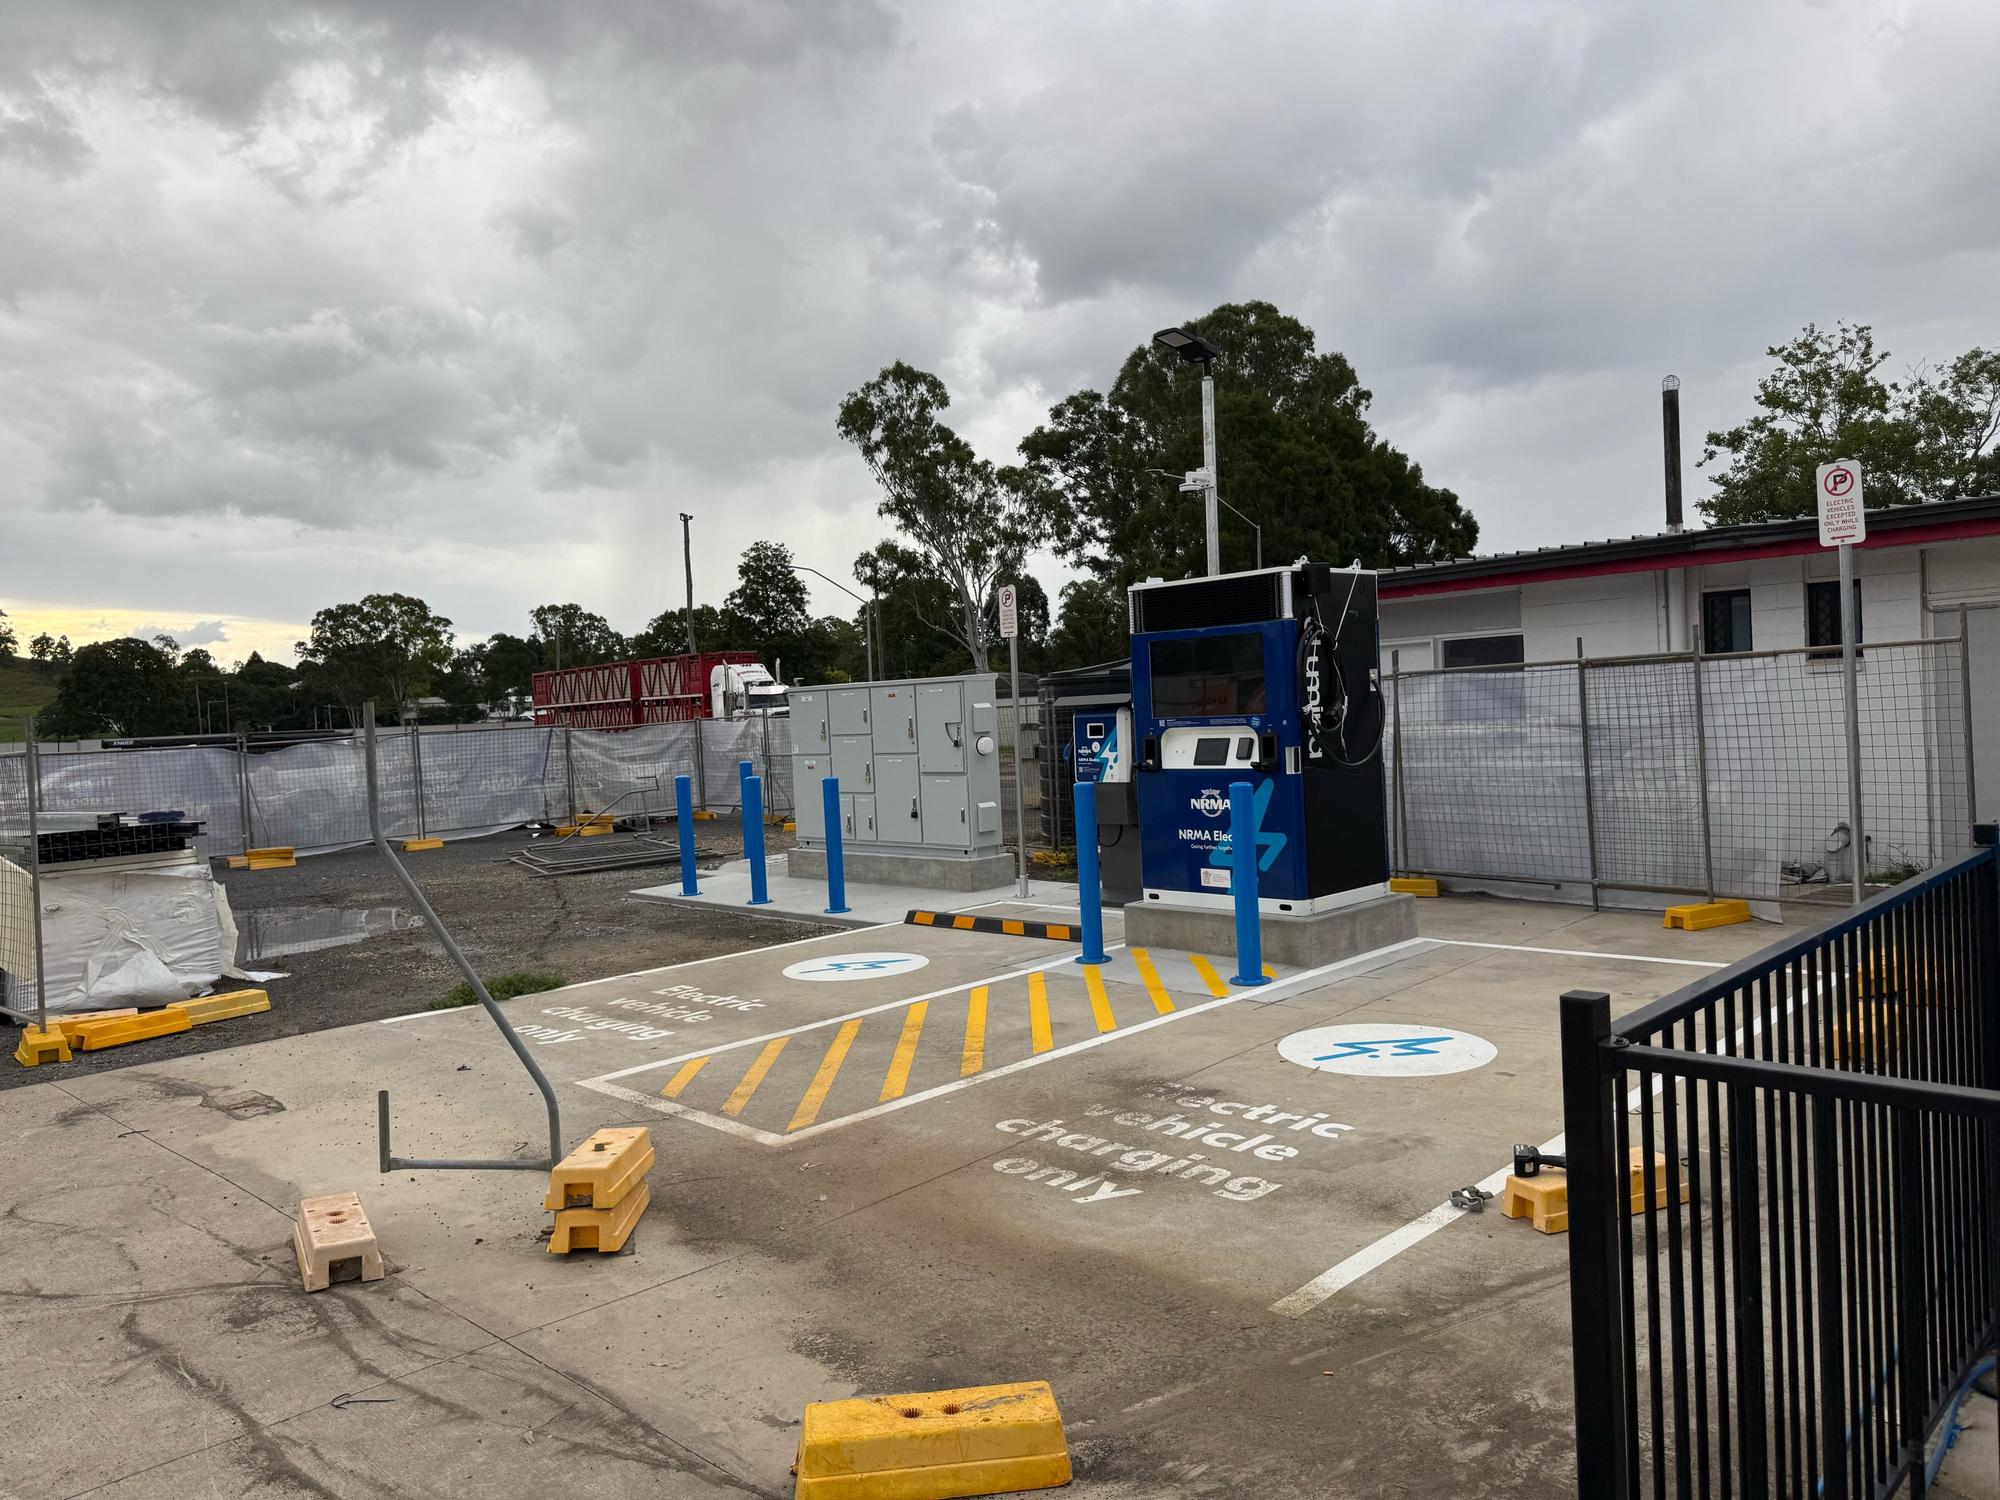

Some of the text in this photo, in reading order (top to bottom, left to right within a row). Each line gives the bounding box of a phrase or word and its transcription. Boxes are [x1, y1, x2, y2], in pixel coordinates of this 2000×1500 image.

[1826, 498, 1854, 507] ELECTRIC
[1826, 505, 1855, 513] VEHICLES
[1826, 511, 1856, 520] EXCEPTED
[1827, 525, 1857, 533] CHARGING
[1190, 798, 1230, 810] NRMA
[1179, 829, 1211, 840] NRMA
[652, 984, 768, 1011] Electric
[607, 997, 713, 1023] vehicle
[541, 1006, 675, 1041] charging
[513, 1024, 587, 1045] only
[1083, 1103, 1299, 1161] vehicle
[994, 1118, 1283, 1201] charging
[992, 1157, 1145, 1204] only
